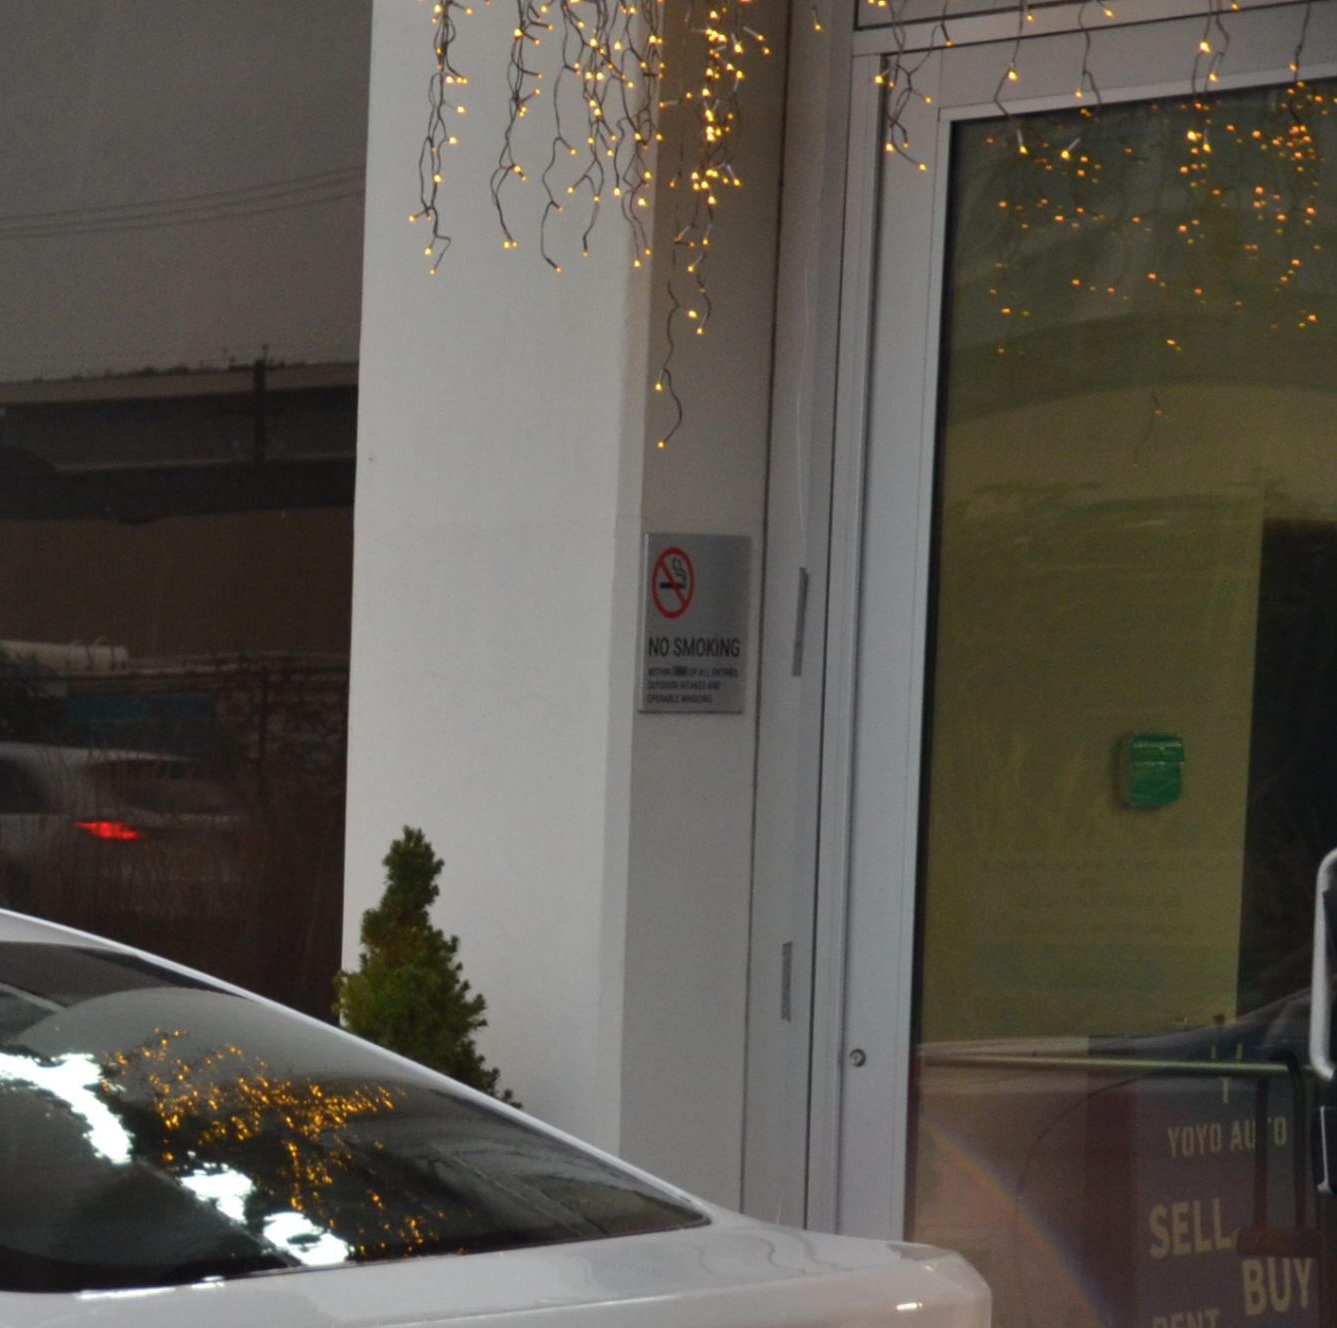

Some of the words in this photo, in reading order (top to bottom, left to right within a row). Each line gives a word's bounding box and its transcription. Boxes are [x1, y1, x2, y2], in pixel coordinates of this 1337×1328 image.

[648, 636, 670, 657] NO
[673, 637, 741, 658] SMOKING
[1167, 1122, 1222, 1159] YOYO
[1229, 1115, 1288, 1150] AUO
[1148, 1197, 1231, 1260] SELL
[1241, 1256, 1312, 1316] BUY
